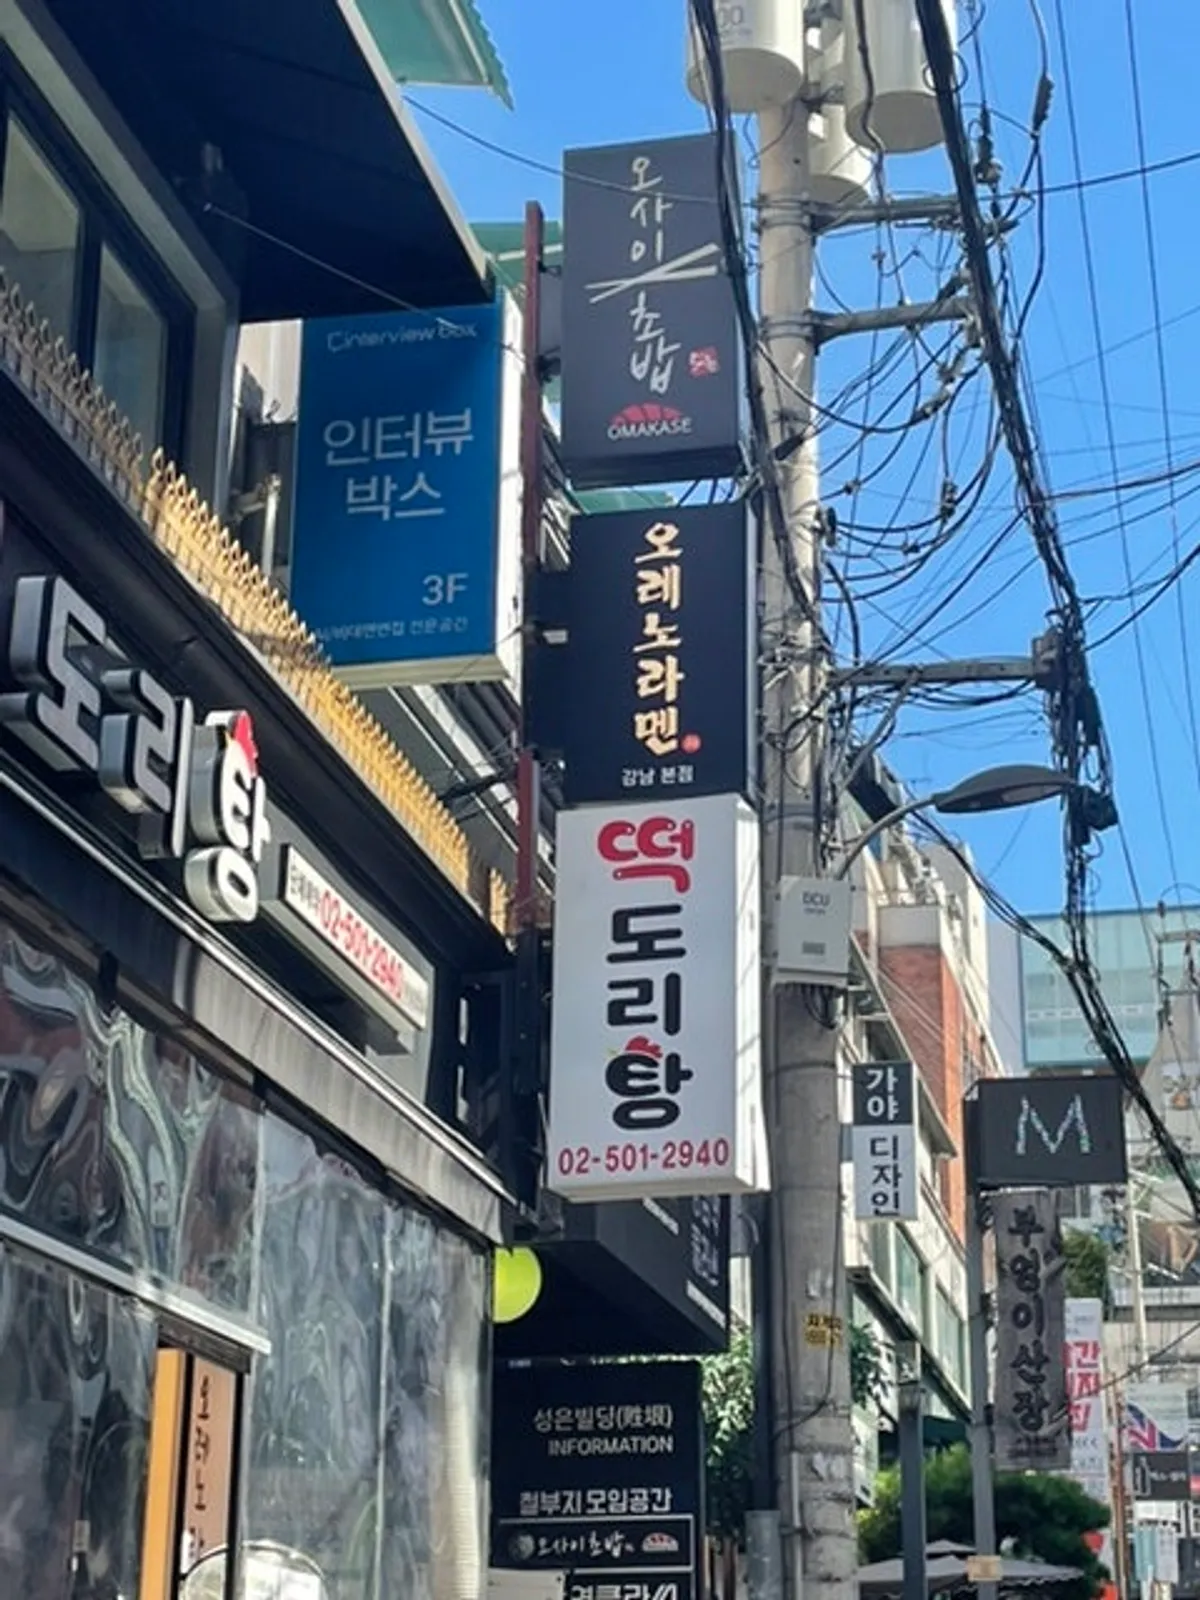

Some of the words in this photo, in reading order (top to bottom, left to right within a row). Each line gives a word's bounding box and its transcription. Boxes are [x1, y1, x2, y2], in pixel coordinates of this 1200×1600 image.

[324, 407, 474, 467] 인터뷰
[607, 417, 692, 441] OMAKASE
[346, 472, 445, 521] 박스
[421, 572, 469, 607] 3F
[632, 521, 685, 756] 오레노라멘
[621, 766, 655, 787] 강남
[660, 764, 694, 784] 본점
[866, 1066, 899, 1121] 가야
[1014, 1093, 1091, 1155] M
[557, 1137, 730, 1177] 02-501-2940
[869, 1135, 902, 1217] 디자인
[1007, 1204, 1051, 1432] 부엉이산장
[547, 1434, 674, 1456] INFORMATION
[586, 1487, 673, 1515] 모임공간
